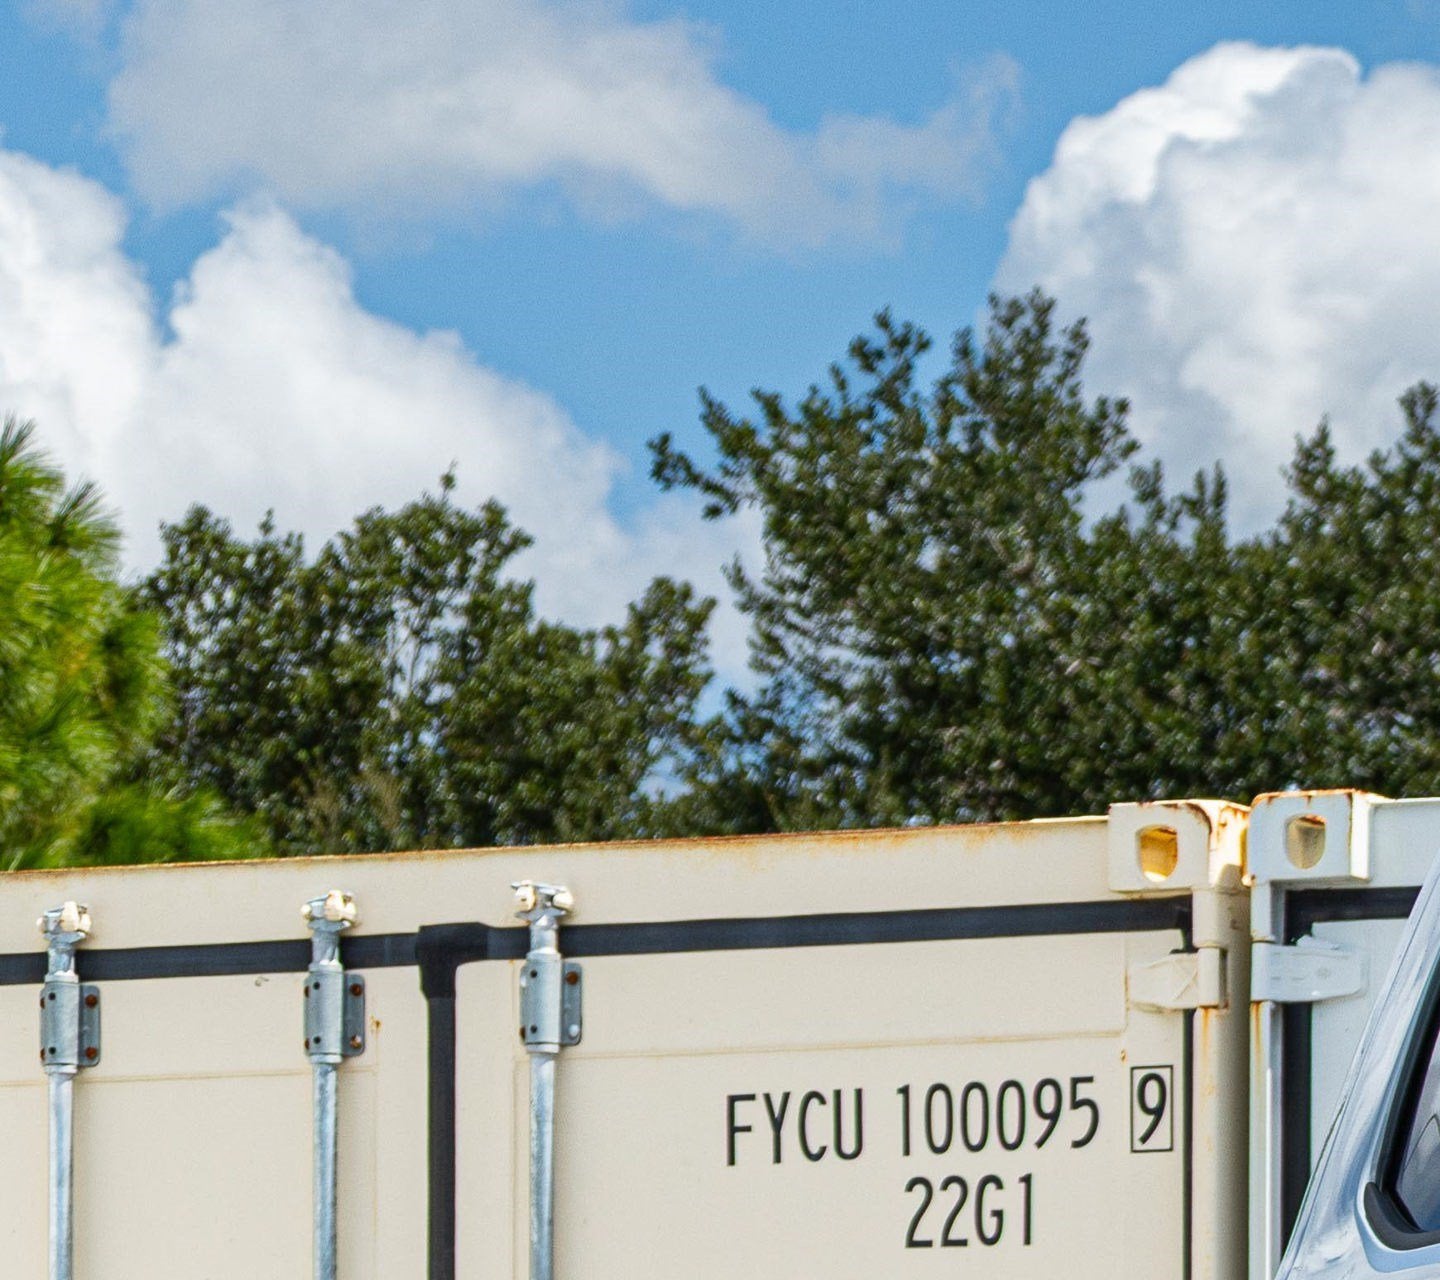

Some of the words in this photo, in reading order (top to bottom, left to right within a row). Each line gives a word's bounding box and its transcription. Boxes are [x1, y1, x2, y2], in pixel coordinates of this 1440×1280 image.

[726, 1088, 864, 1166] FYCU
[895, 1075, 1100, 1157] 100095
[1136, 1072, 1168, 1146] 9
[904, 1172, 1034, 1249] 22G1
